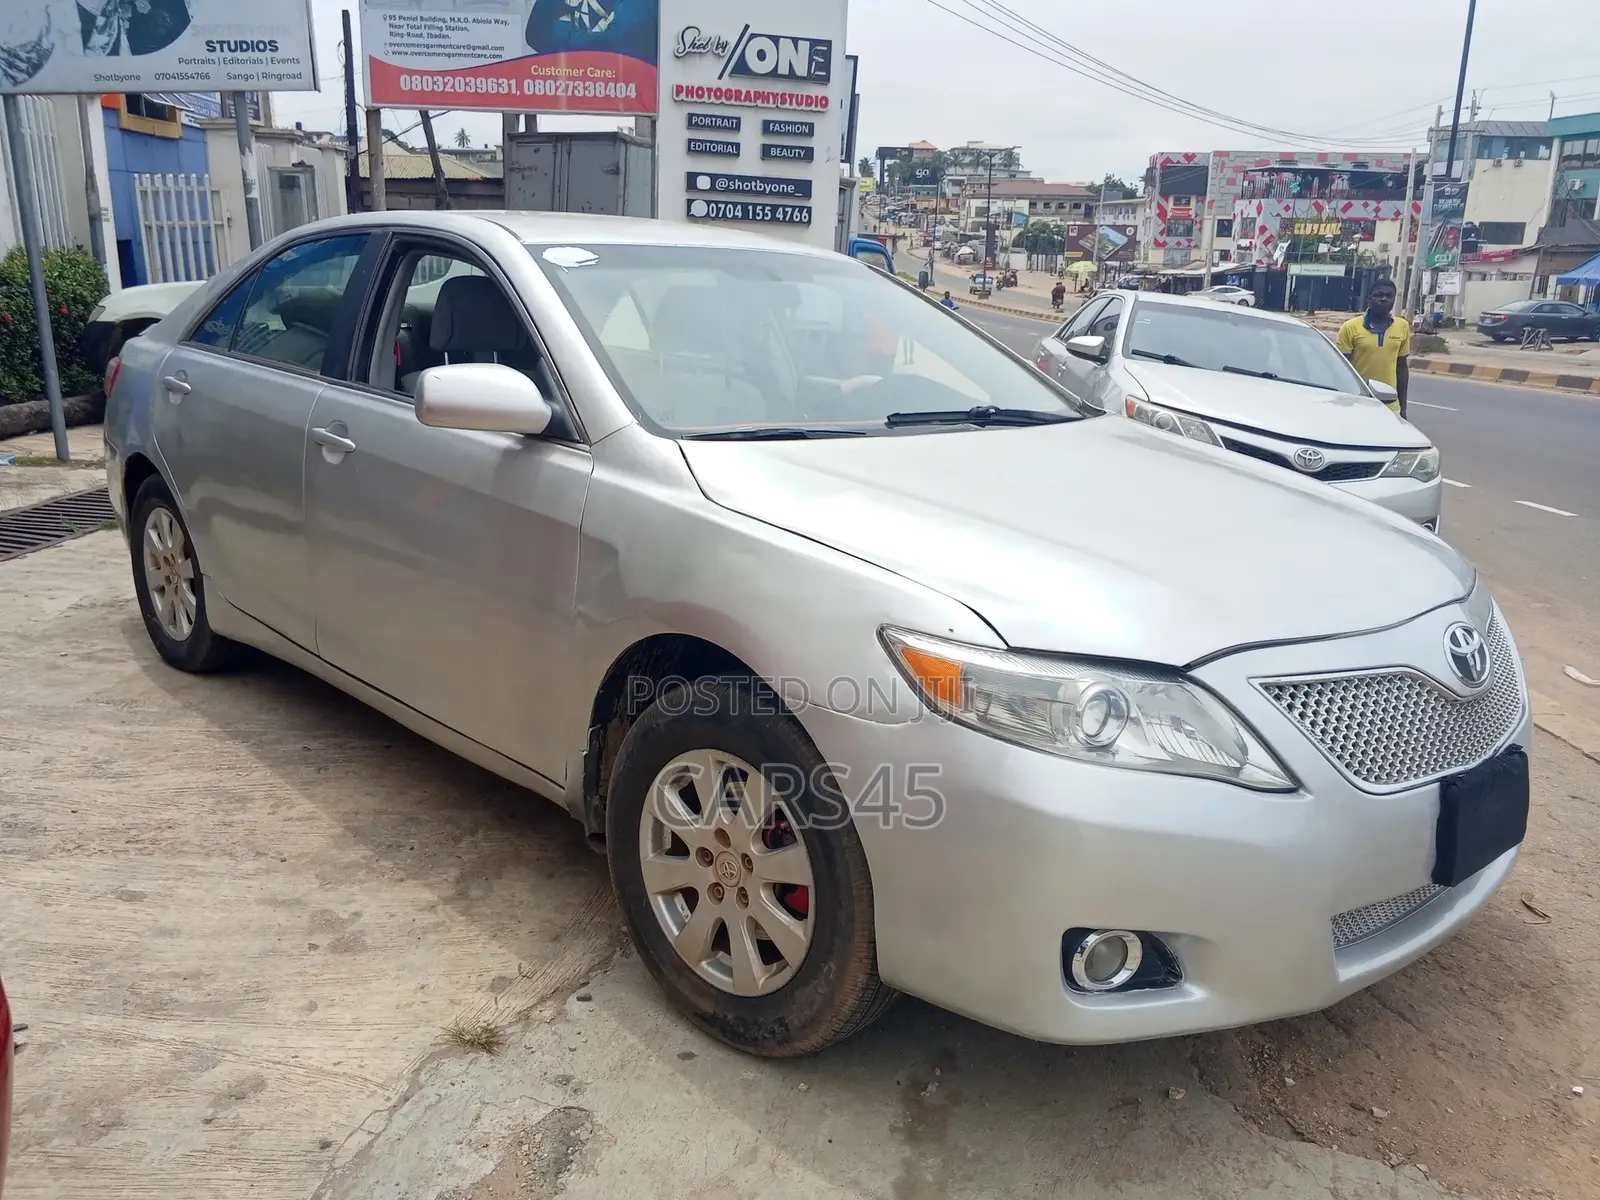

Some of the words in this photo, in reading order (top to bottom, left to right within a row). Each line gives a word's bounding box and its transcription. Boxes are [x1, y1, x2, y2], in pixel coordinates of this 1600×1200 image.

[420, 16, 448, 24] Building,
[493, 18, 510, 26] Way,
[424, 24, 444, 32] Filling
[389, 32, 425, 40] Ring-Road,
[675, 25, 712, 56] Shot
[714, 36, 728, 56] by
[205, 39, 279, 53] STUDIOS
[388, 42, 505, 52] overcomersgarmentcare@gmail.com
[391, 50, 503, 60] www.overcomersgarmentcare.com
[178, 57, 216, 65] Portraits
[223, 57, 264, 65] Editorials
[271, 57, 301, 65] Events
[154, 72, 211, 81] 07041554766
[226, 72, 255, 82] Sango
[262, 71, 303, 81] Ringroad
[531, 65, 585, 77] Customer
[587, 67, 616, 78] Care:
[94, 73, 141, 83] Shotbyone
[400, 74, 520, 96] 08032039631,
[523, 79, 637, 98] 08027338404
[691, 115, 738, 128] PORTRAIT
[769, 122, 809, 134] FASHION
[690, 141, 738, 154] EDITORIAL
[770, 147, 806, 158] BEAUTY
[715, 177, 803, 196] @shotbyone_
[709, 203, 743, 219] 0704
[747, 204, 772, 220] 155
[776, 206, 809, 222] 4766
